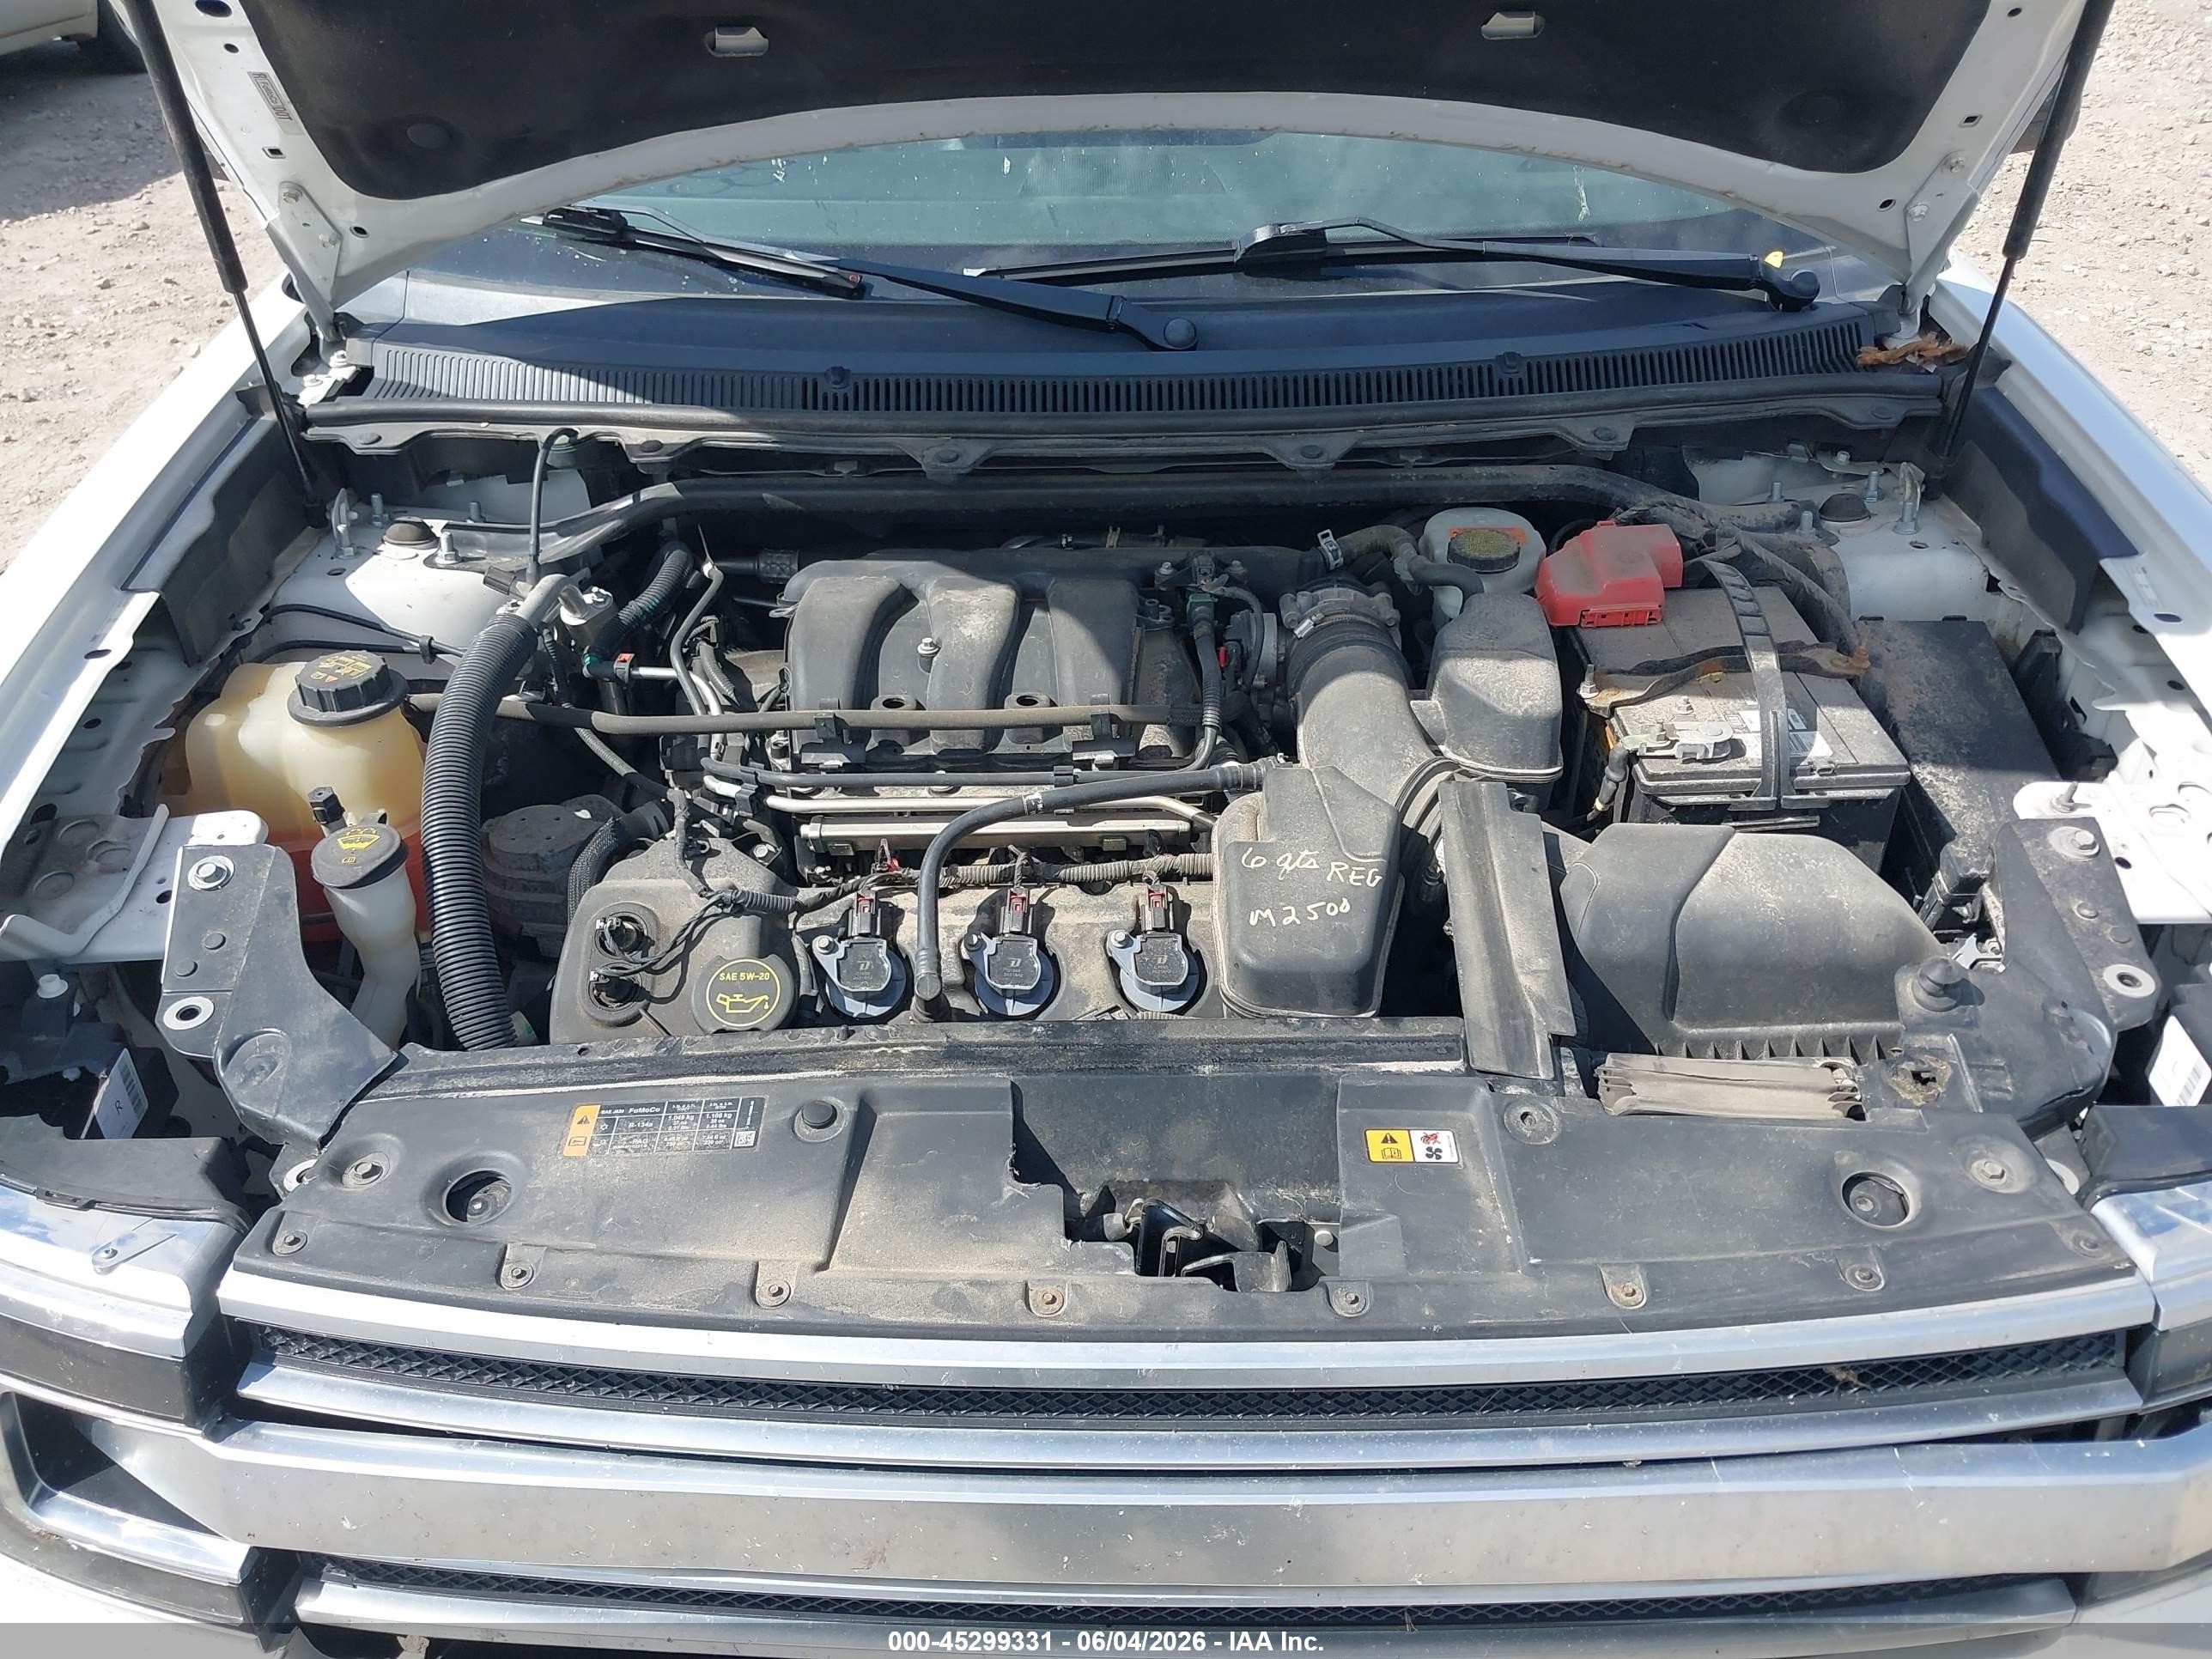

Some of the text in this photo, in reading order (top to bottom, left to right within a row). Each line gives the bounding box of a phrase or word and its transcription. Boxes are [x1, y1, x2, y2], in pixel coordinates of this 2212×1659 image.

[1242, 847, 1382, 887] 6 qts REG
[720, 972, 770, 981] SAE 5W-20
